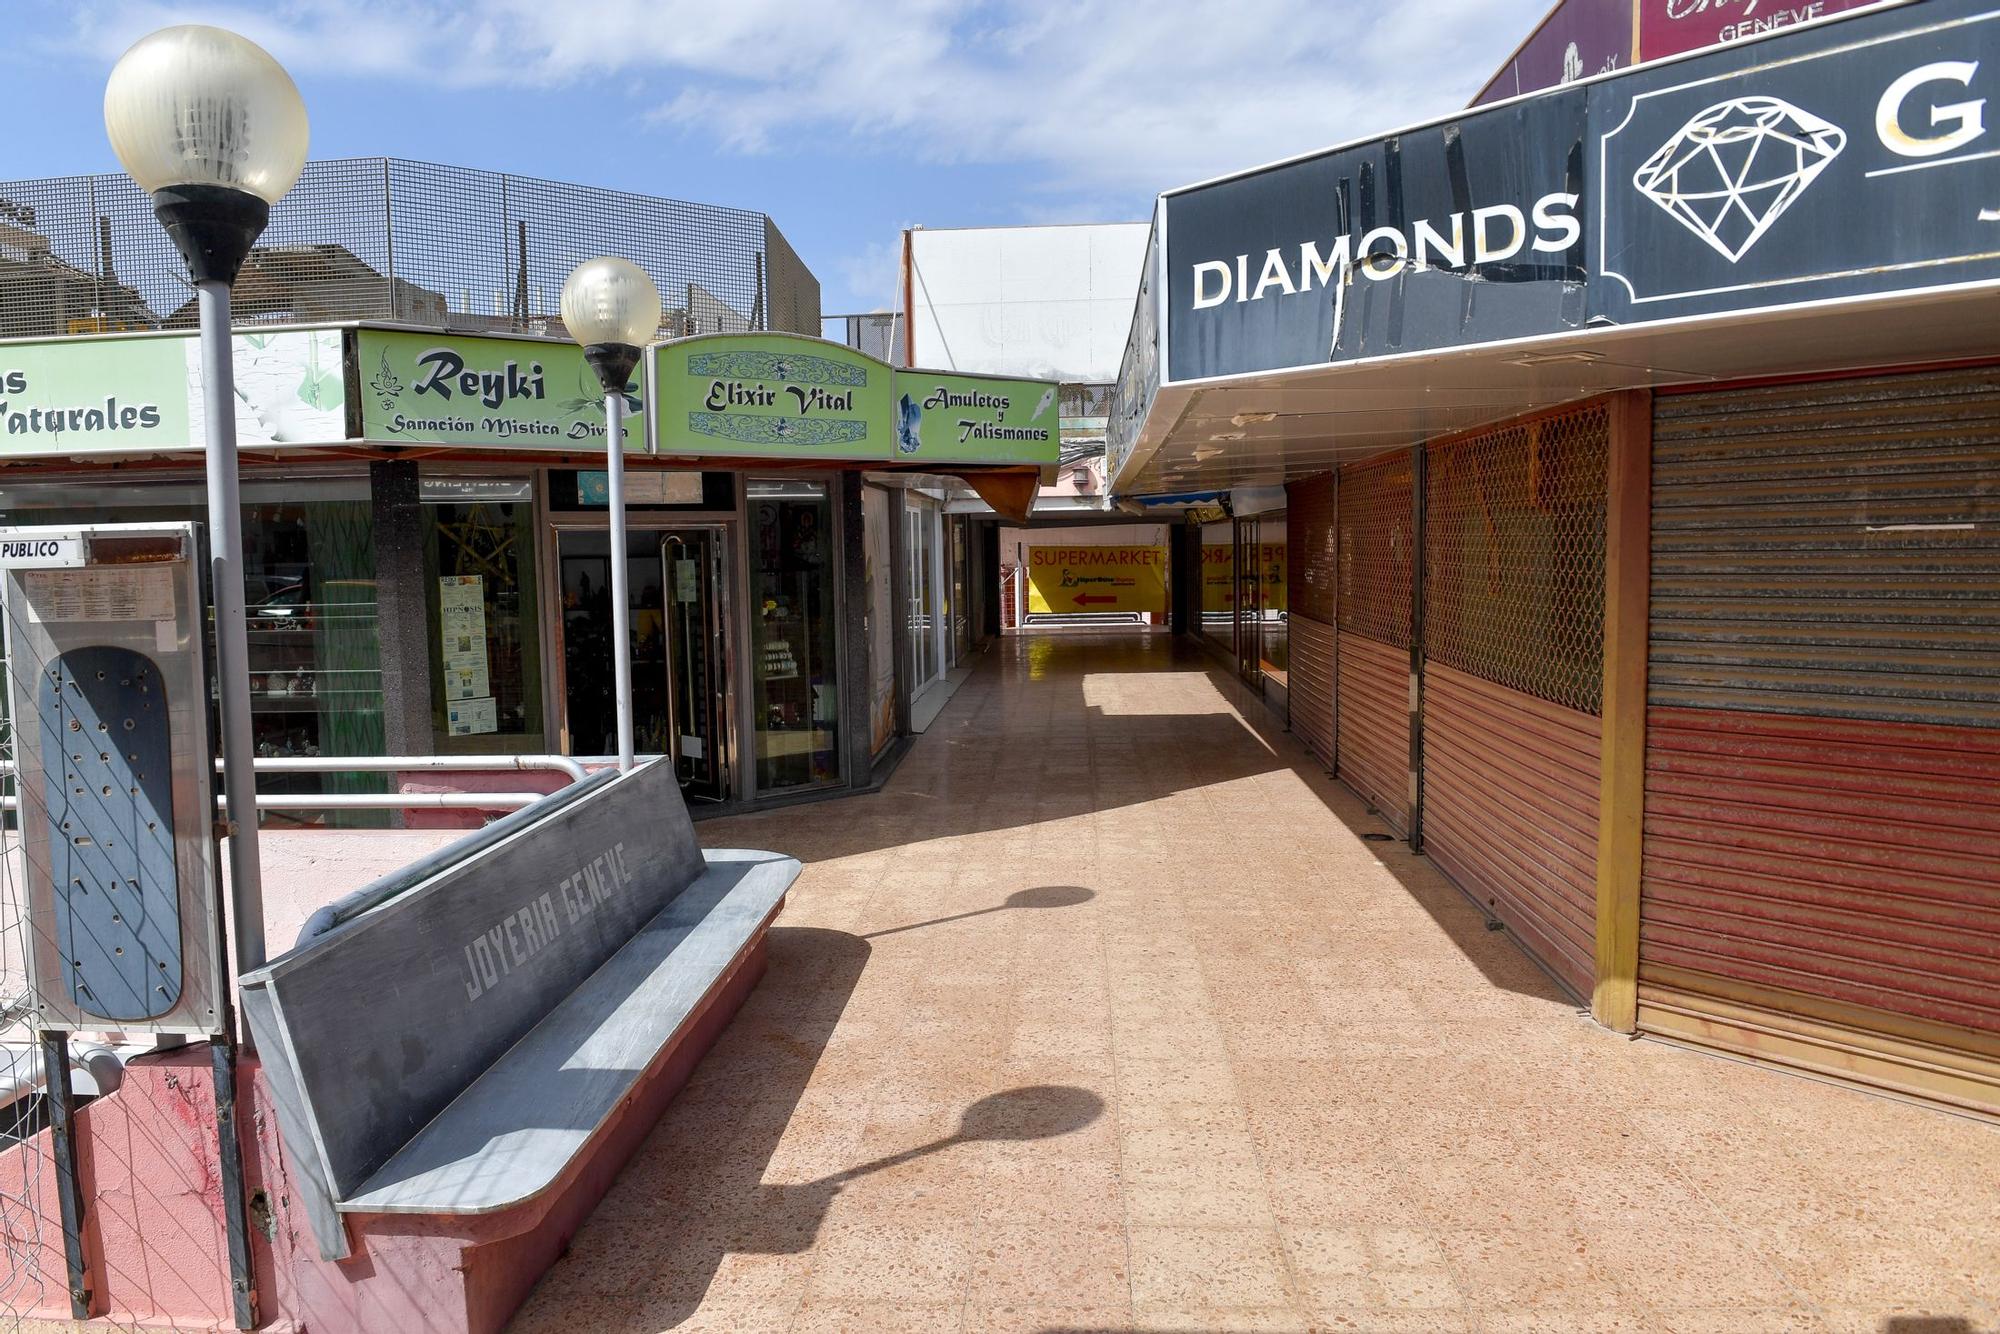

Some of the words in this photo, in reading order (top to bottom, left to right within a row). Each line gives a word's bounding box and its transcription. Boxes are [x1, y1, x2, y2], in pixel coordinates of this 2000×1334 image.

[1192, 192, 1582, 310] DIAMONDS
[412, 350, 545, 410] Reyki
[705, 380, 776, 412] Elixir
[785, 385, 853, 415] Vital
[923, 387, 1010, 410] Amuletos
[386, 414, 475, 433] Sanación
[481, 417, 560, 438] Mistica
[998, 411, 1004, 422] y
[958, 420, 1049, 443] Talismanes
[1, 541, 59, 558] PUBLICO
[1034, 550, 1160, 566] SUPERMARKET
[463, 891, 561, 1002] JOYERIA
[559, 841, 633, 926] GENEVE
